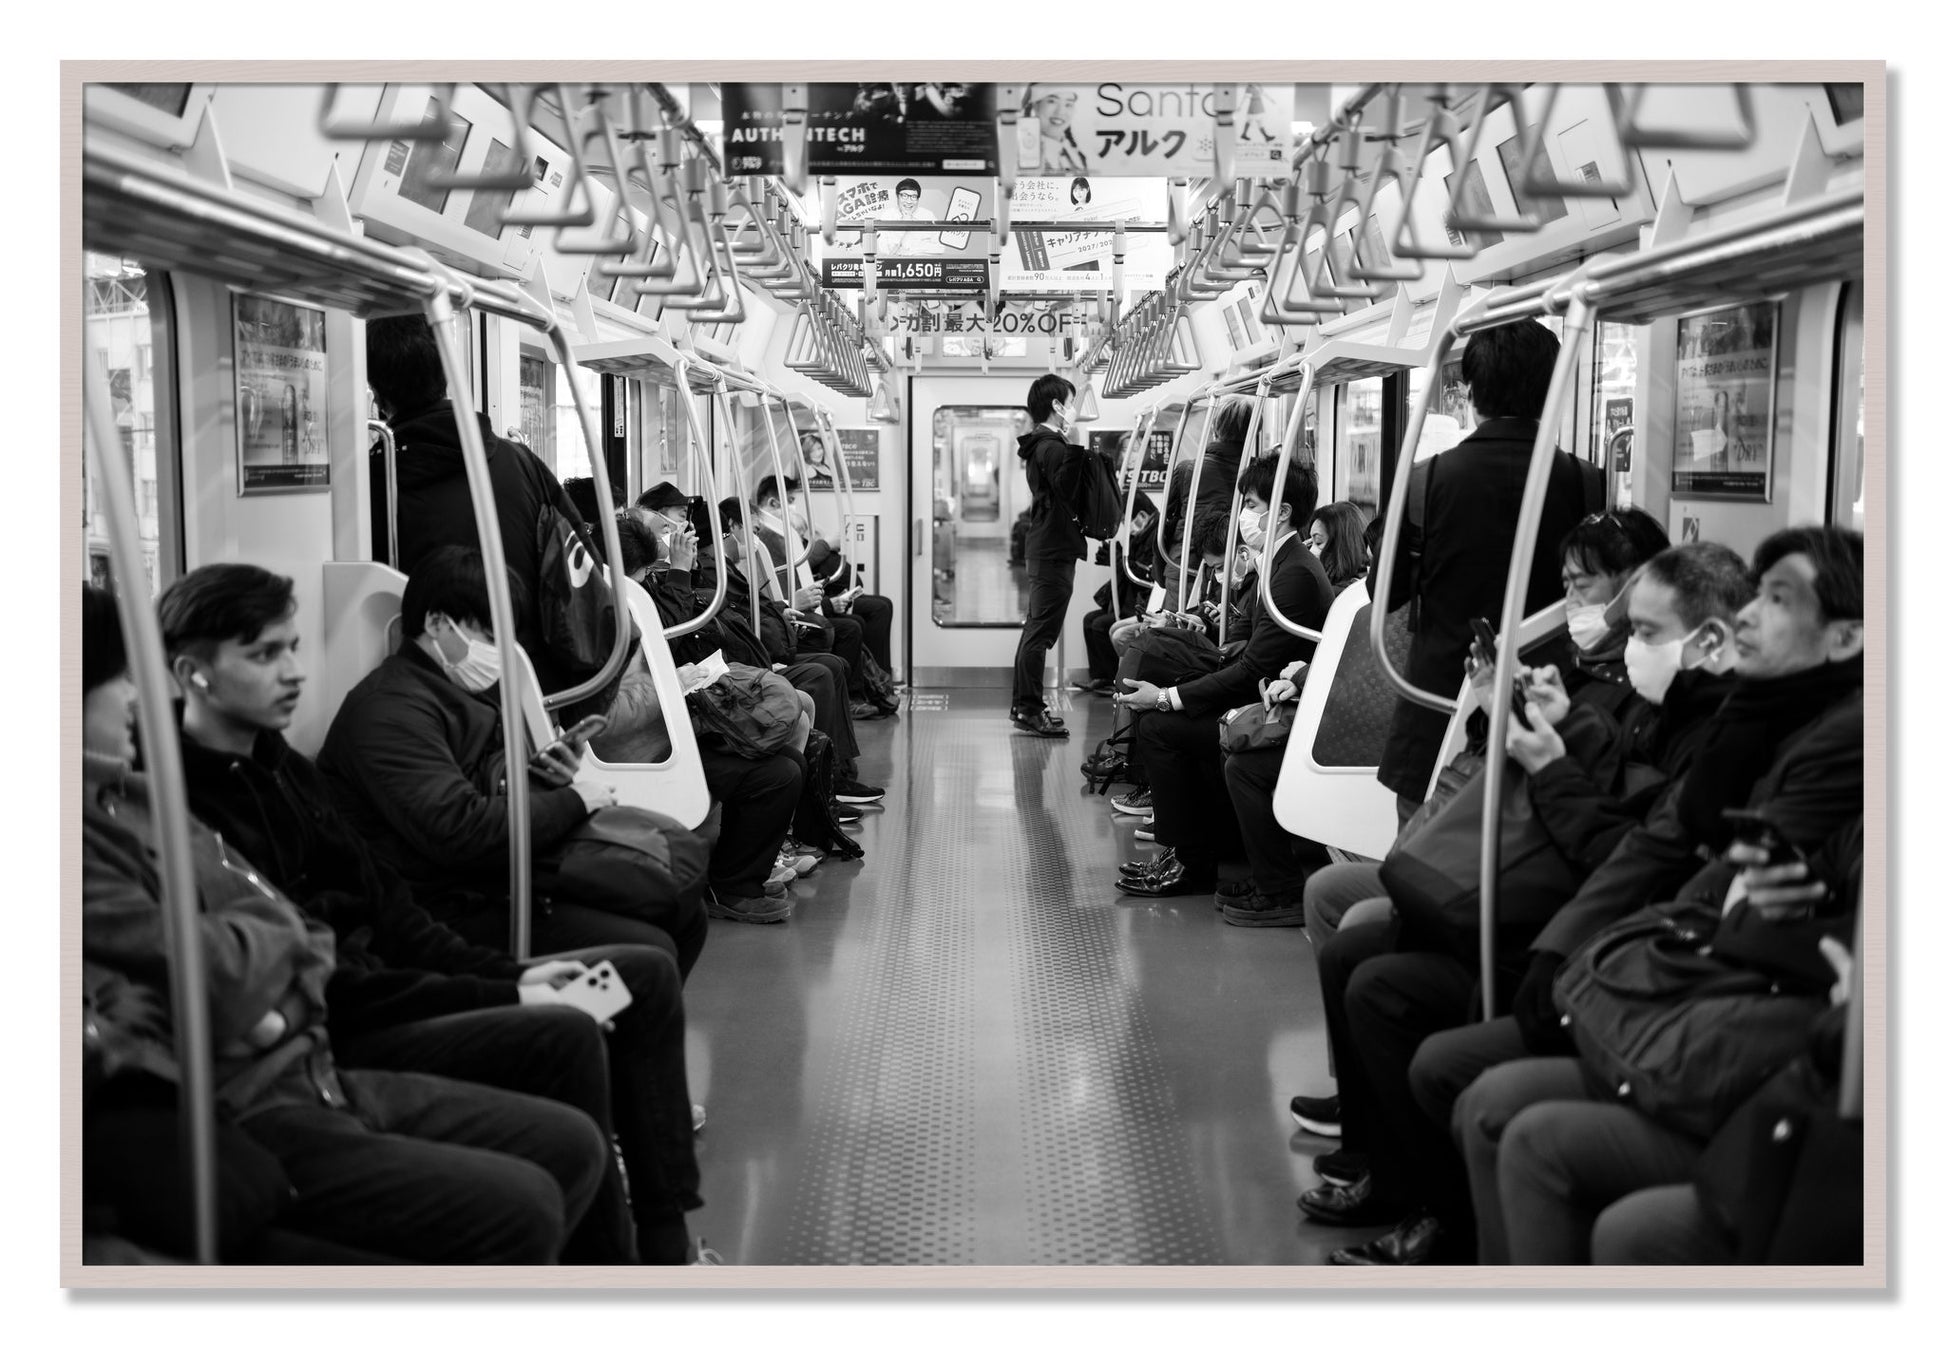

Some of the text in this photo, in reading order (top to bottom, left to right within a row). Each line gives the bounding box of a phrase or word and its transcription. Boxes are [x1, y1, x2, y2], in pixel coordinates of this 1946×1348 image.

[731, 127, 865, 142] AUTHNTECH
[1096, 130, 1187, 159] アルク
[1078, 239, 1113, 253] 2027/202
